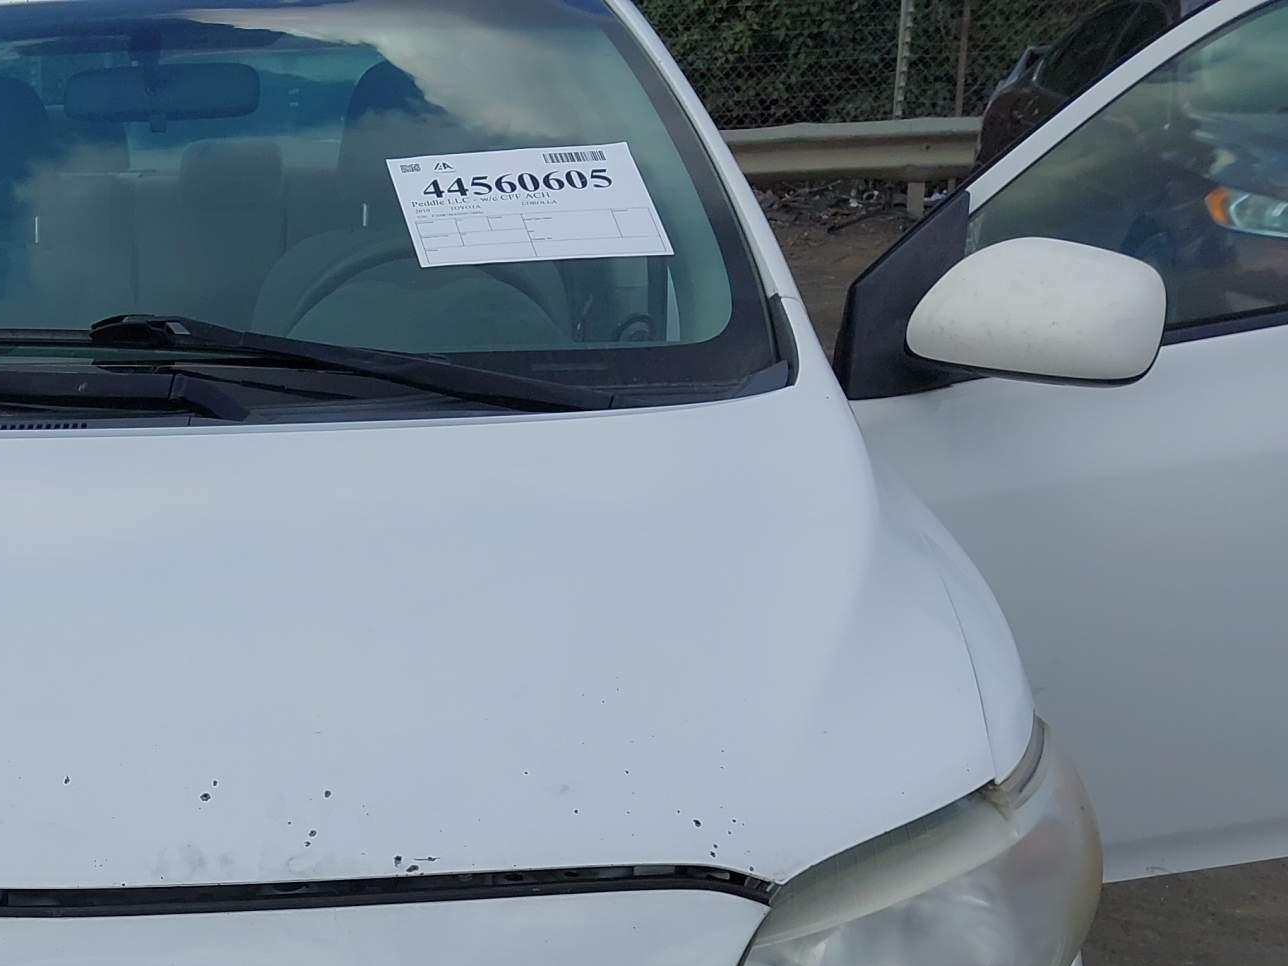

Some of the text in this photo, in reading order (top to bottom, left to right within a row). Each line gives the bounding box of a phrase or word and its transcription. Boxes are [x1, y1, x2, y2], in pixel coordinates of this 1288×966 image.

[423, 168, 613, 199] 44560605
[411, 199, 445, 208] Peddle
[447, 197, 470, 206] LLC
[525, 191, 552, 199] ACH
